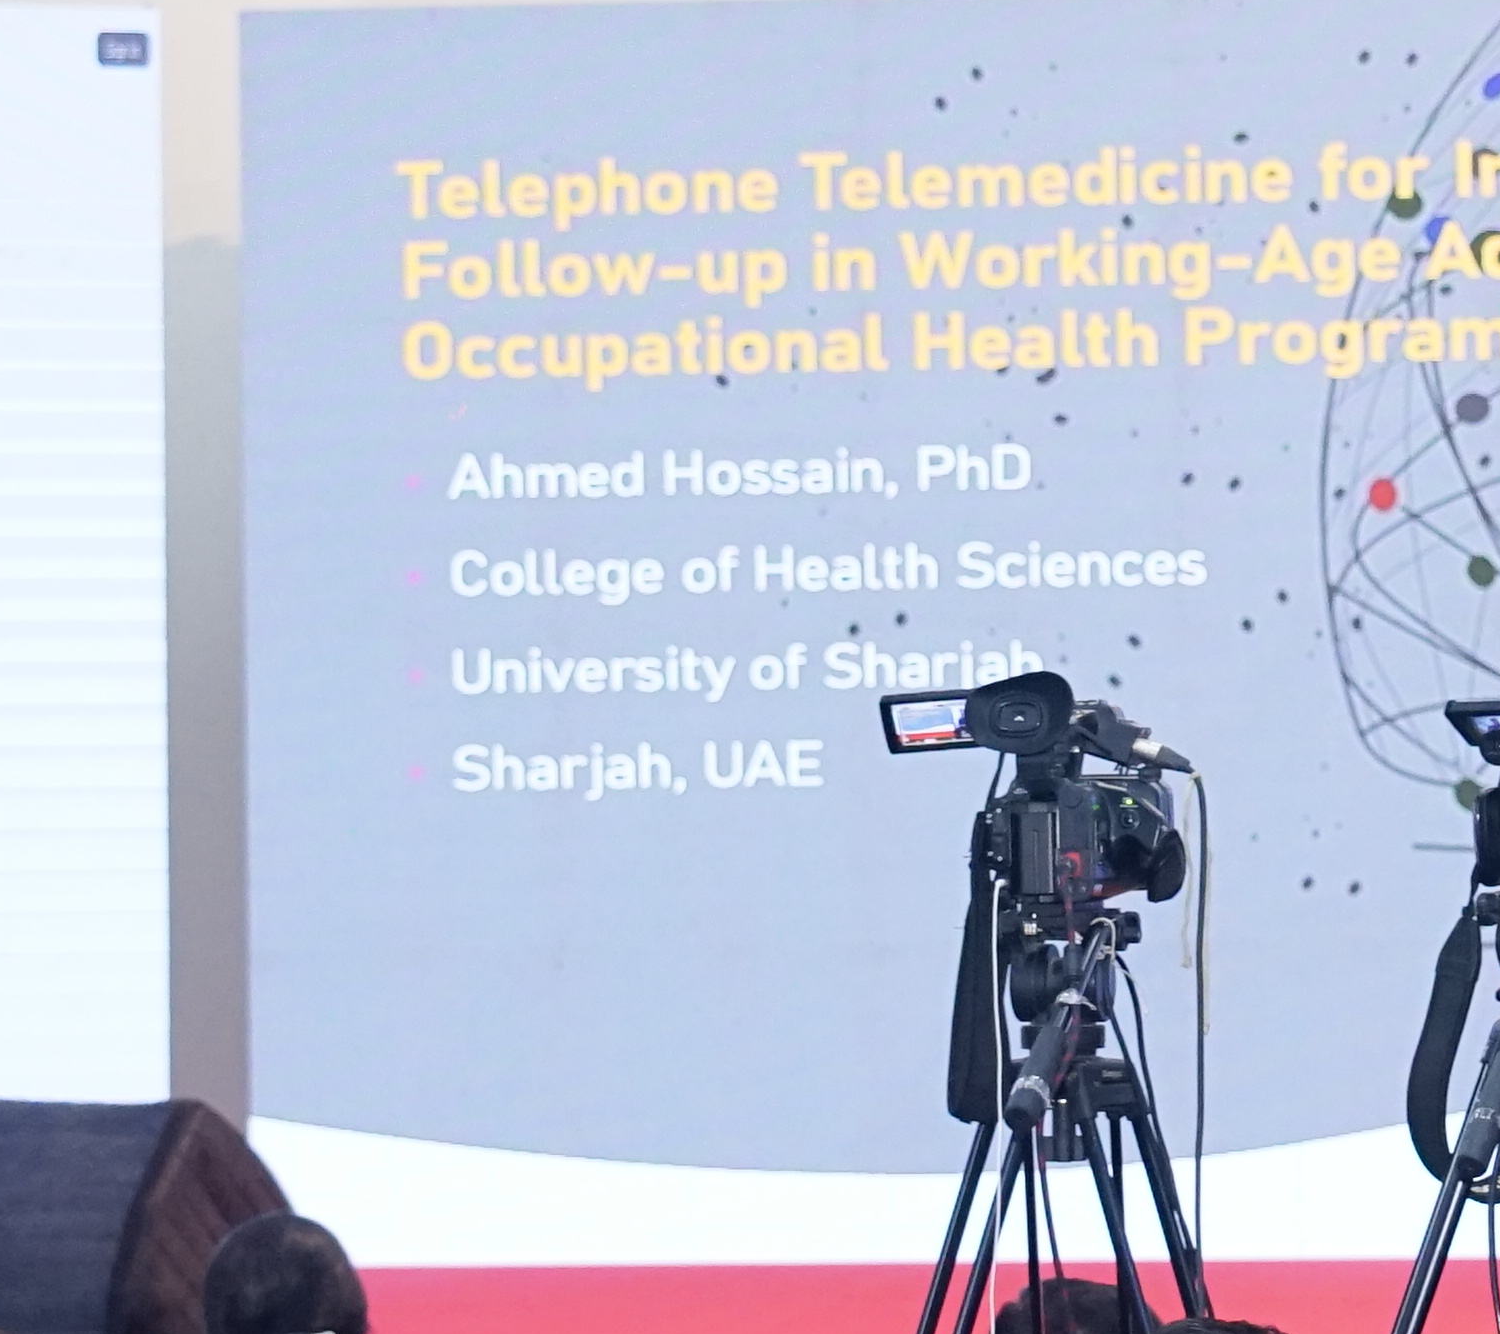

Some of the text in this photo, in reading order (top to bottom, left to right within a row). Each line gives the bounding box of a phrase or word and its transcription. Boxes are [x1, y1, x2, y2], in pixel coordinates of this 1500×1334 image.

[399, 160, 775, 228] Telephone
[802, 147, 1289, 208] Telemedicine
[1321, 145, 1427, 198] for
[405, 242, 784, 305] Follow-up
[814, 236, 873, 288] in
[404, 315, 885, 389] Occupational
[916, 311, 1155, 368] Health
[449, 444, 1030, 501] Ahmed Hossain, PhD
[452, 542, 1207, 605] College of Health Sciences
[454, 648, 734, 702] University
[751, 644, 805, 689] of
[455, 741, 822, 800] Sharjah, UAE
